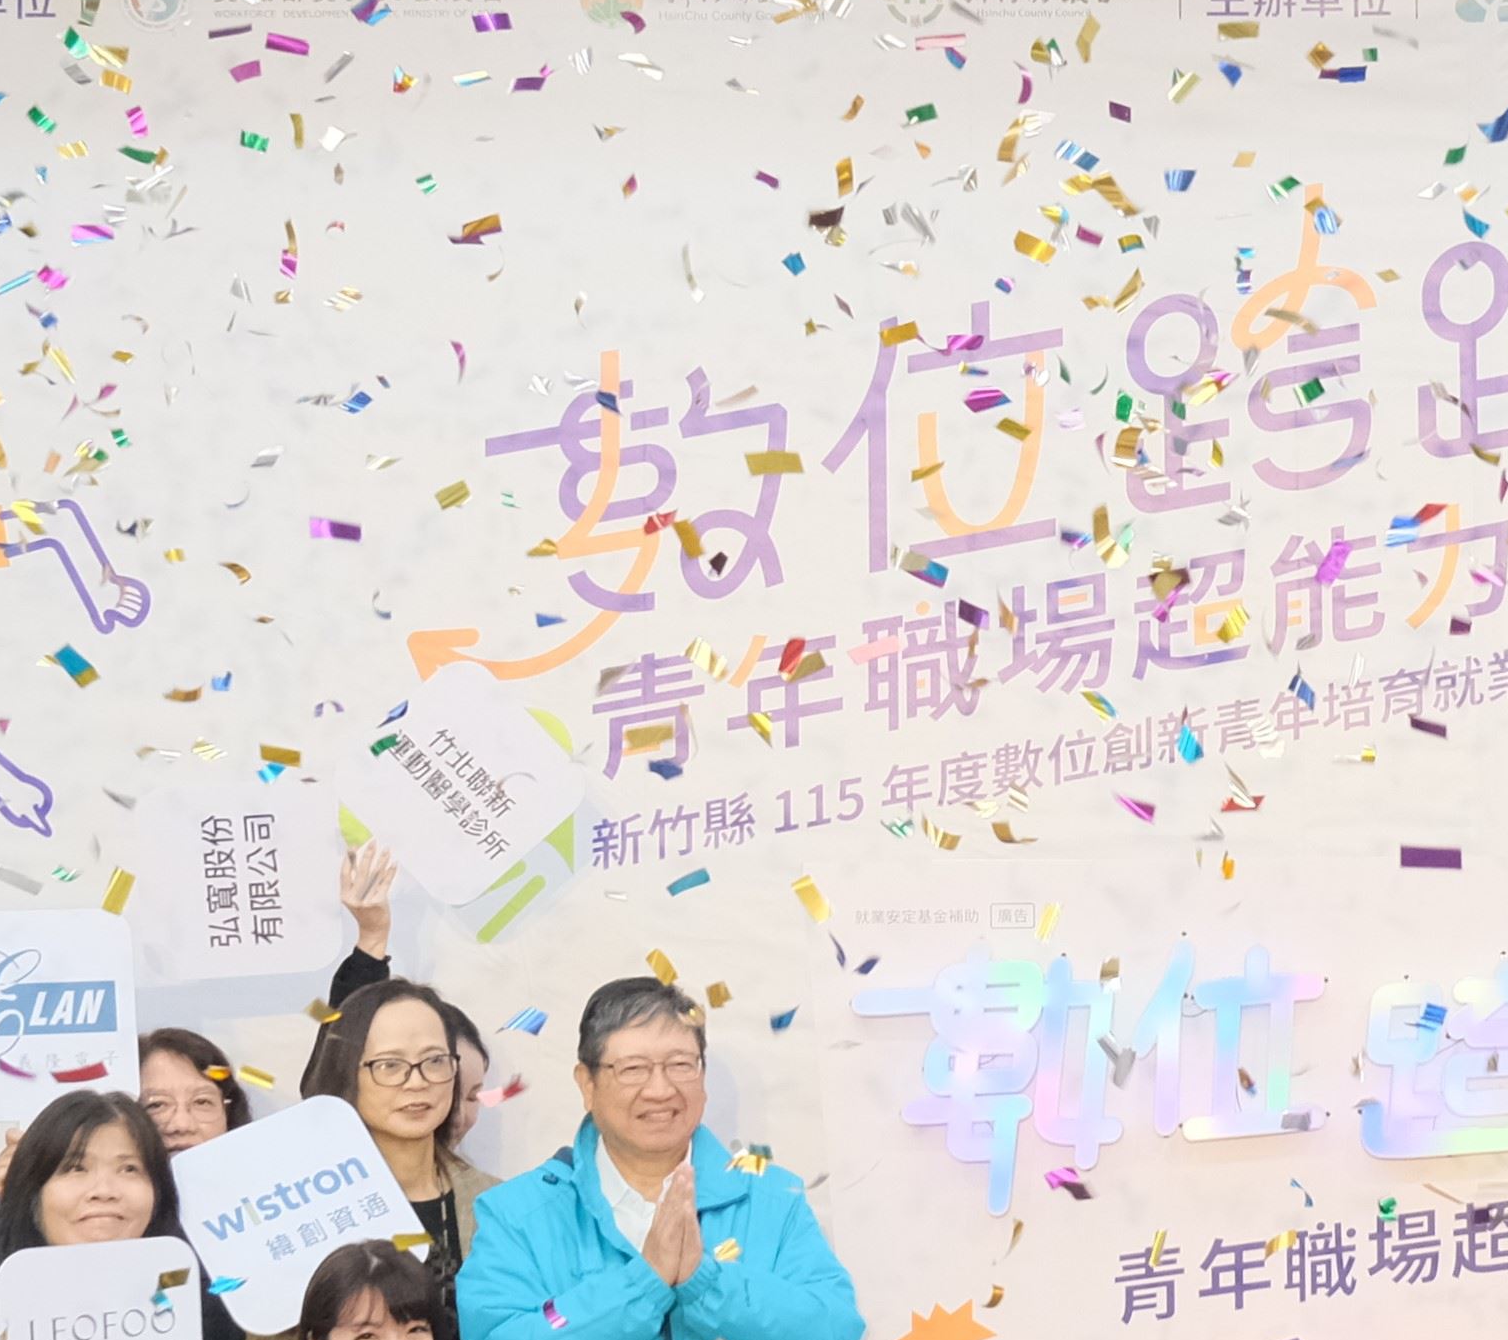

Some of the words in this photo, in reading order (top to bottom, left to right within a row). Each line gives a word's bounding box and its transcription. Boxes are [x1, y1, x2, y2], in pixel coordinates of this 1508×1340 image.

[283, 10, 352, 19] DEVELOPMEN
[388, 728, 511, 861] 運動醫學診所
[427, 728, 516, 818] 竹北聯新
[592, 791, 757, 871] 新竹縣
[773, 776, 866, 836] 115
[243, 811, 285, 944] 有限公司
[201, 1156, 370, 1242] wistron
[264, 1191, 391, 1262] 緯創資通
